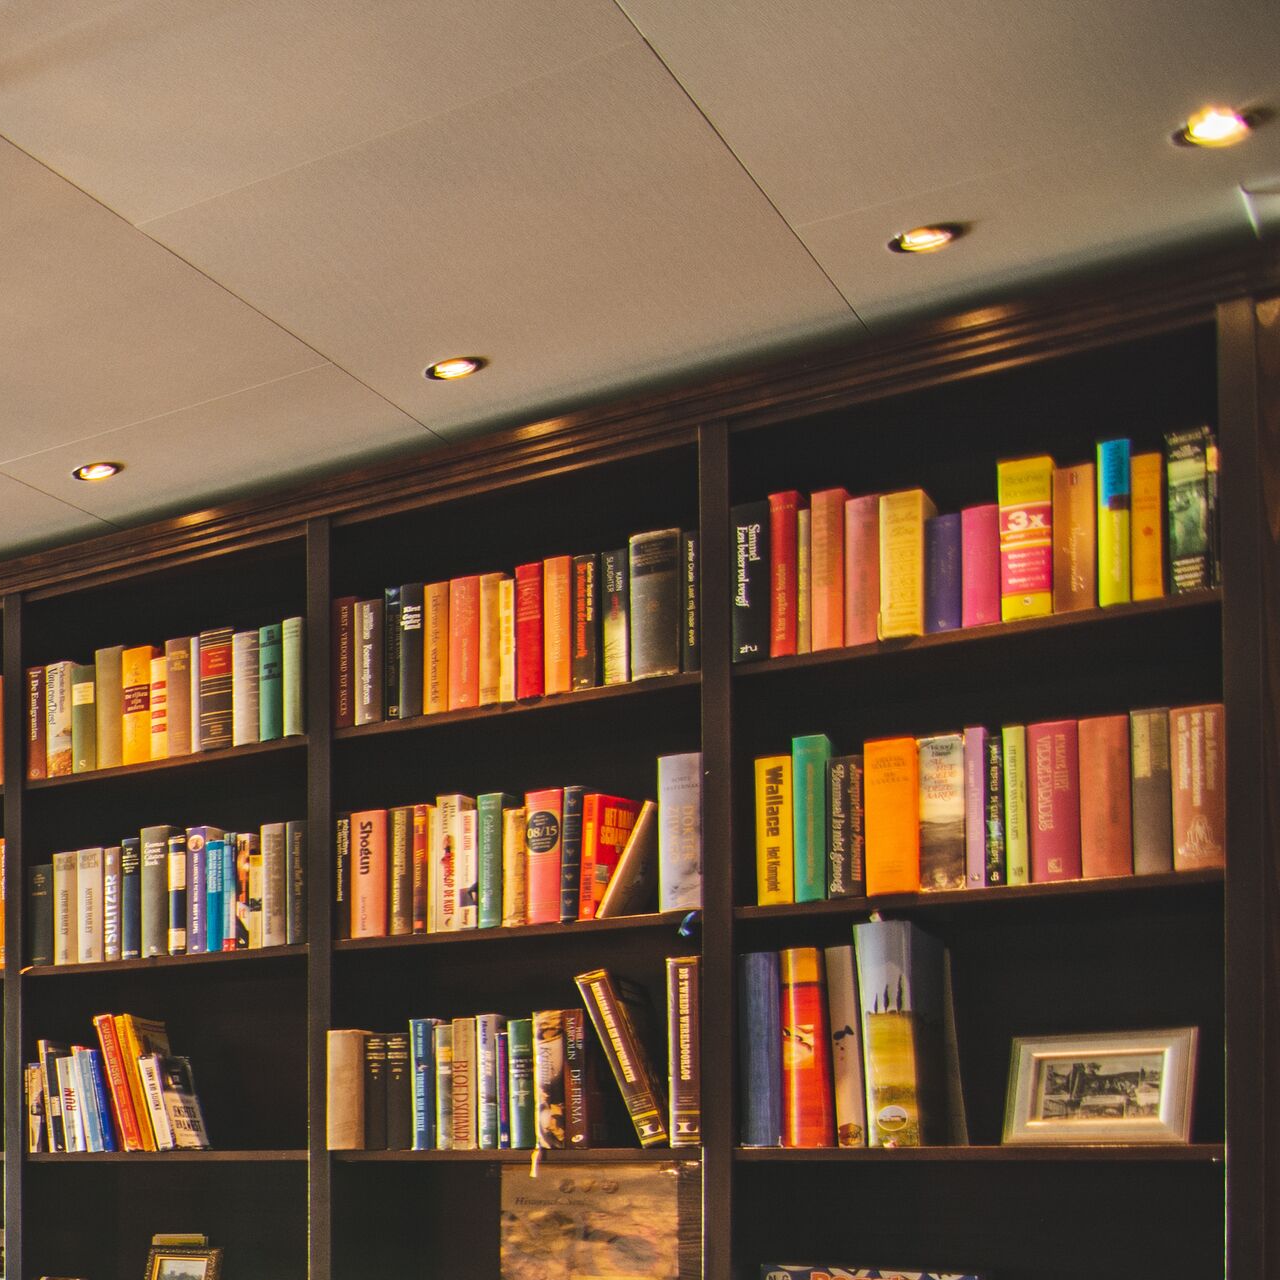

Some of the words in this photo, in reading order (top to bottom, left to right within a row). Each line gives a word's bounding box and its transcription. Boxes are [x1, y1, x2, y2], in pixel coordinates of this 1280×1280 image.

[1007, 510, 1045, 530] 3x
[737, 527, 747, 544] Een
[749, 524, 760, 561] Simmel
[737, 545, 748, 568] beker
[606, 557, 614, 593] SLAUGHTER
[738, 568, 749, 582] vol
[735, 582, 749, 607] vergif
[31, 679, 39, 692] De
[30, 692, 39, 741] Emigranten
[449, 805, 457, 817] JILL
[765, 766, 783, 837] Wallace
[683, 805, 696, 861] DOKTER
[359, 821, 373, 875] Shogun
[767, 847, 780, 860] Het
[444, 879, 454, 888] OP
[765, 861, 780, 892] Komplot
[60, 889, 68, 913] ARTHUR
[85, 888, 93, 912] ARTHUR
[105, 875, 117, 944] SULITZER
[443, 900, 454, 915] KUST
[85, 913, 93, 934] HAILEY
[678, 968, 689, 979] DE
[590, 982, 618, 1028] RENAISSANCE
[678, 980, 689, 1015] TWEEDE
[567, 1017, 576, 1060] MARGOLIN
[608, 1028, 619, 1038] EN
[101, 1023, 115, 1052] SUSKE
[109, 1058, 122, 1086] WISKE
[610, 1038, 636, 1083] REFORMATIE
[679, 1016, 691, 1080] WERELDOORLOG
[416, 1072, 424, 1097] TORENS
[571, 1069, 581, 1085] DE
[452, 1060, 469, 1142] BLOEDSCHANDE
[571, 1088, 582, 1124] FIRMA
[417, 1111, 425, 1131] STILTE
